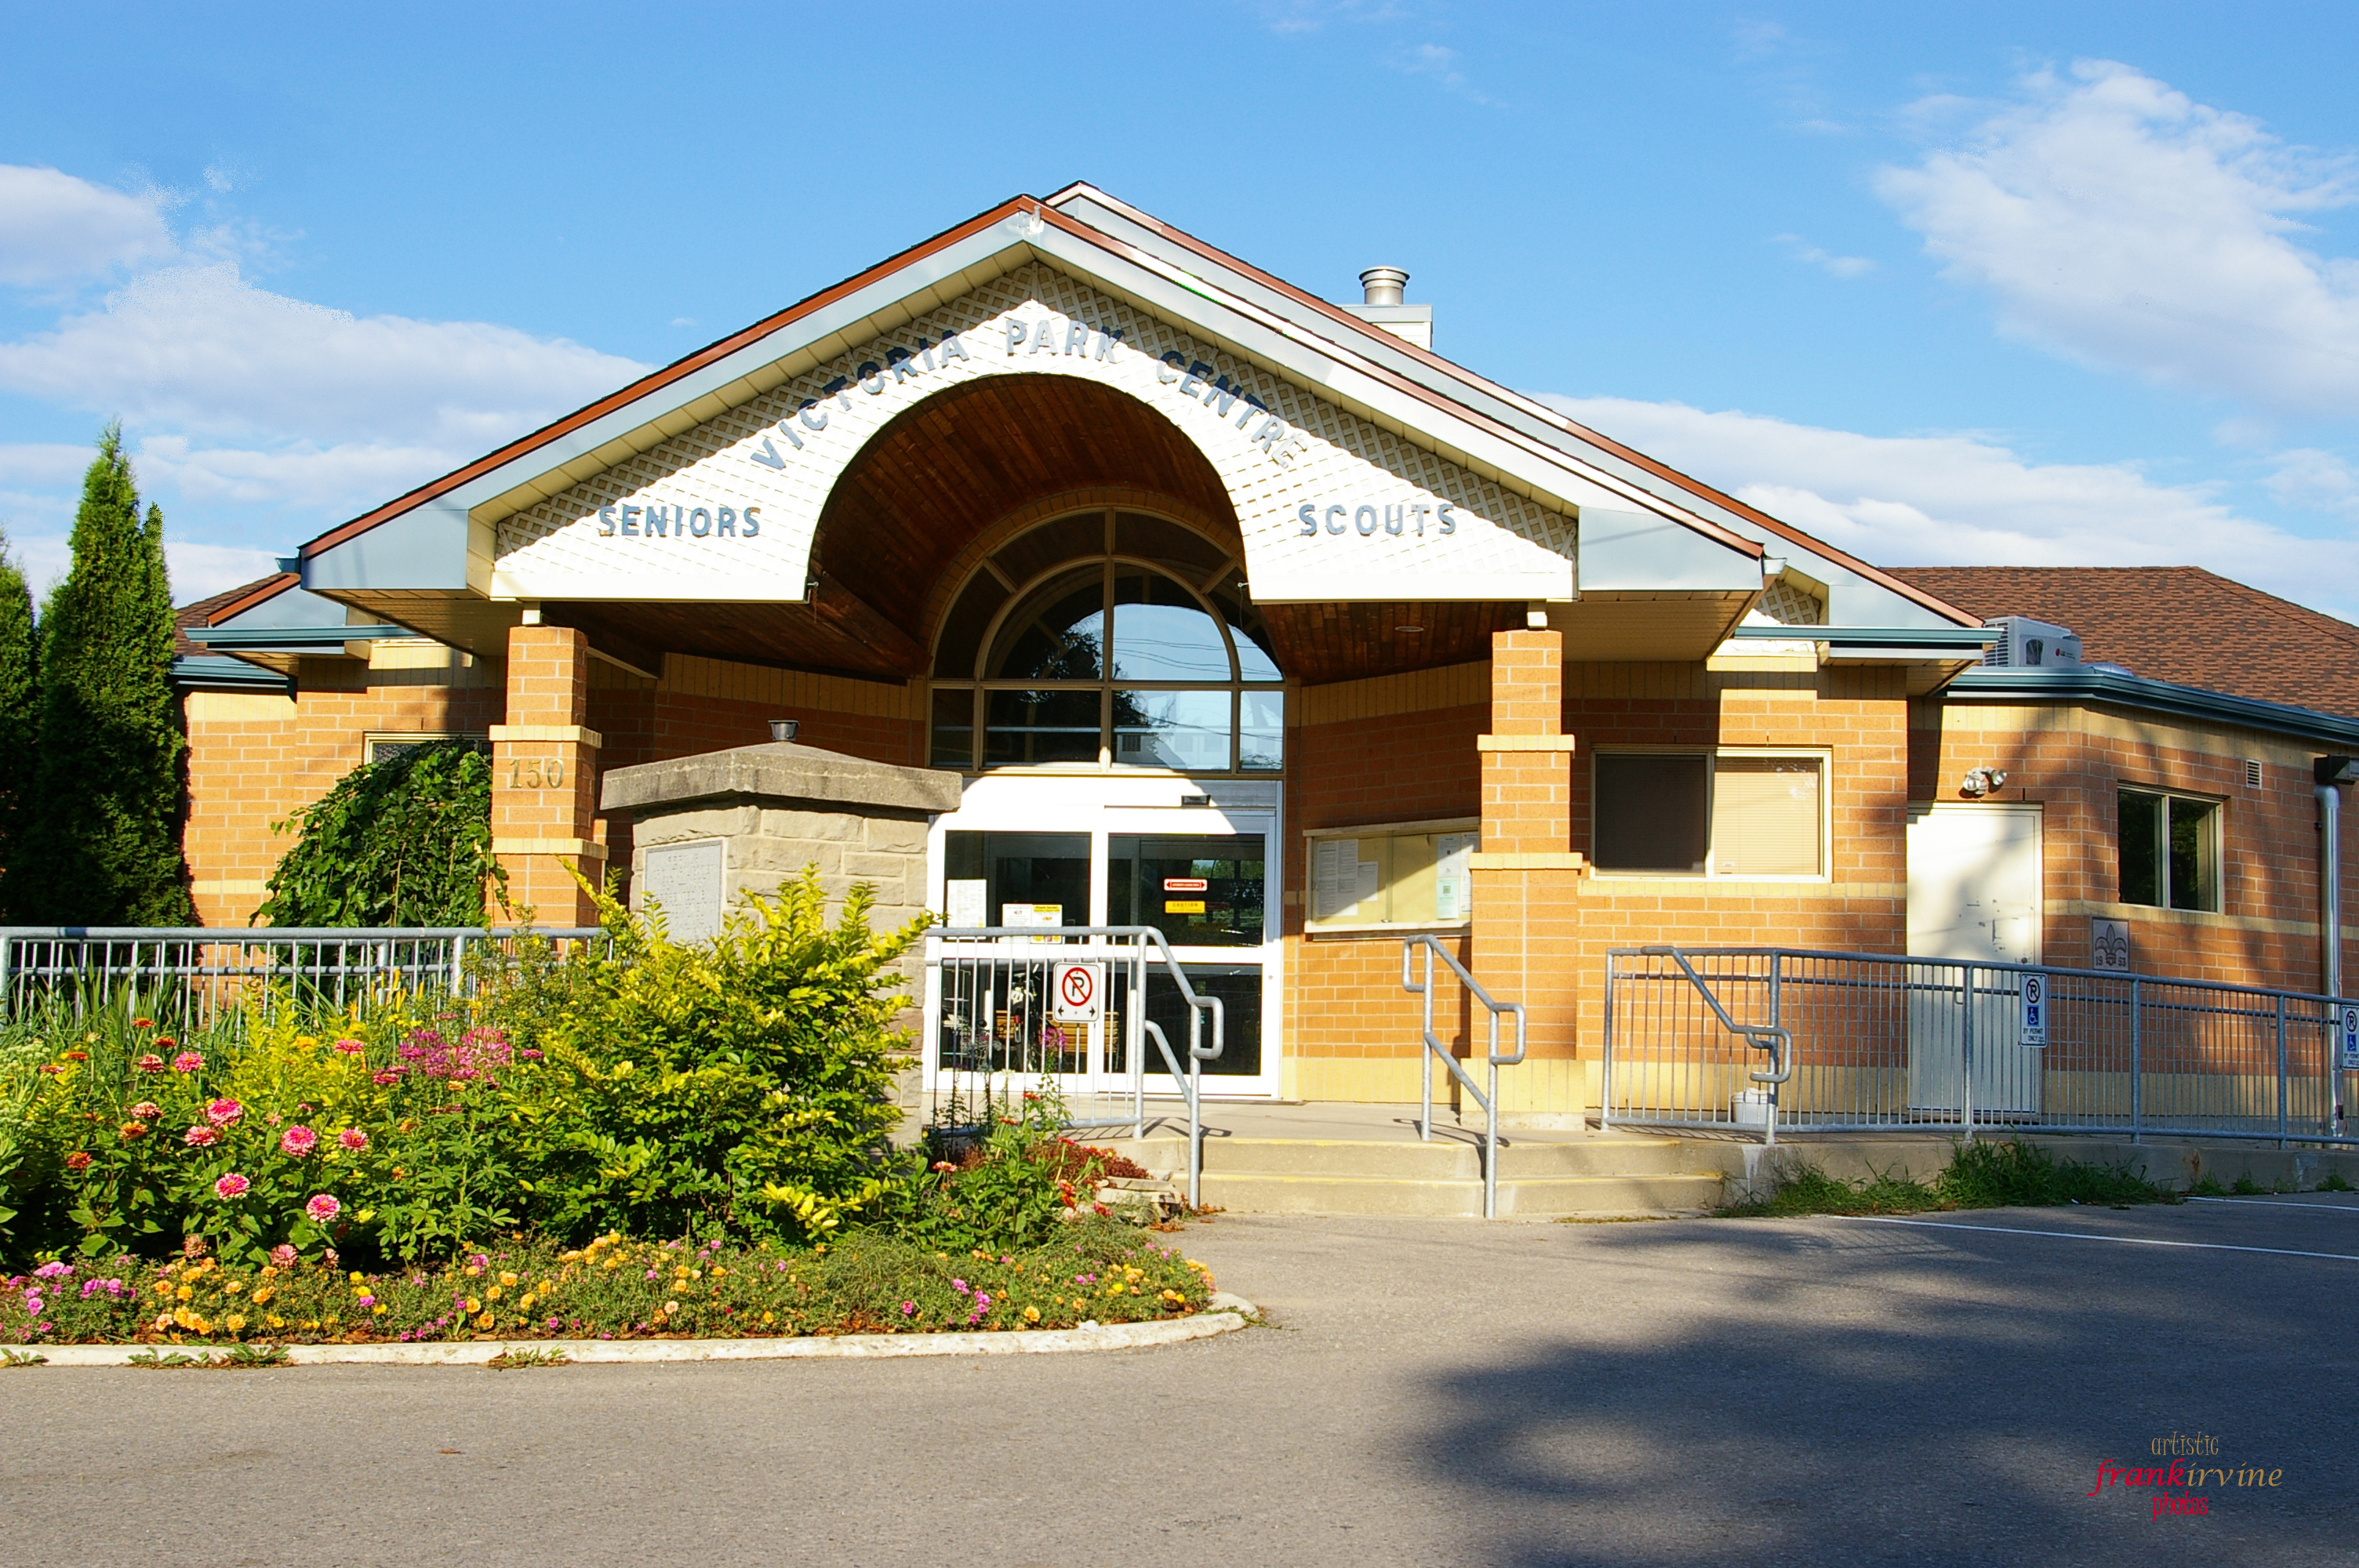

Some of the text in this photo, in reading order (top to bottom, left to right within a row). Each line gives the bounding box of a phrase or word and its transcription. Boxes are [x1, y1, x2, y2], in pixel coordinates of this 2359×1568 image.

[750, 319, 1309, 470] VICTORIA PARK CENTRE
[598, 504, 761, 538] SENIORS
[1298, 503, 1457, 537] SCOUTS
[510, 758, 564, 789] 150
